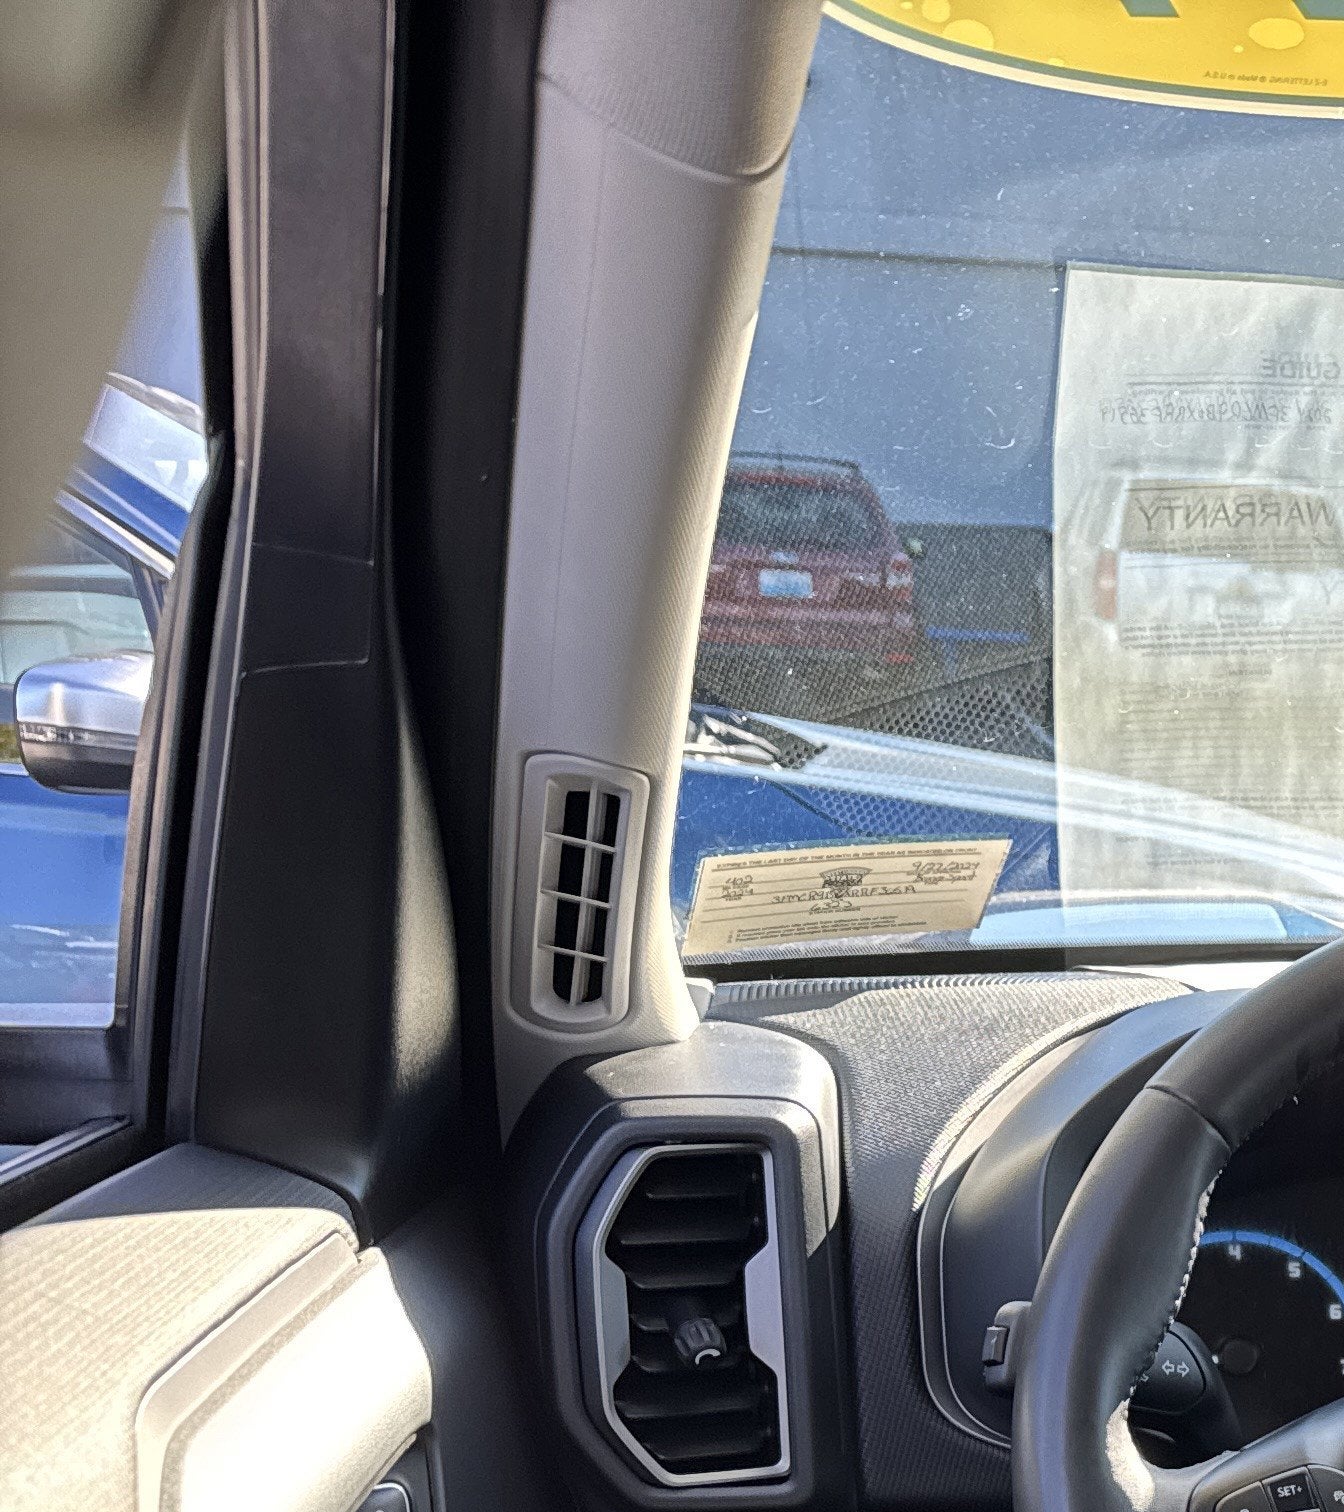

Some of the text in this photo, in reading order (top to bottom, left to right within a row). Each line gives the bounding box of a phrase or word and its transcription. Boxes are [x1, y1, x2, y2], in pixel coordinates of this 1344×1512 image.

[1228, 1244, 1242, 1260] 4
[1287, 1262, 1302, 1278] 5
[1329, 1304, 1342, 1320] 6
[1277, 1484, 1303, 1498] SET+
